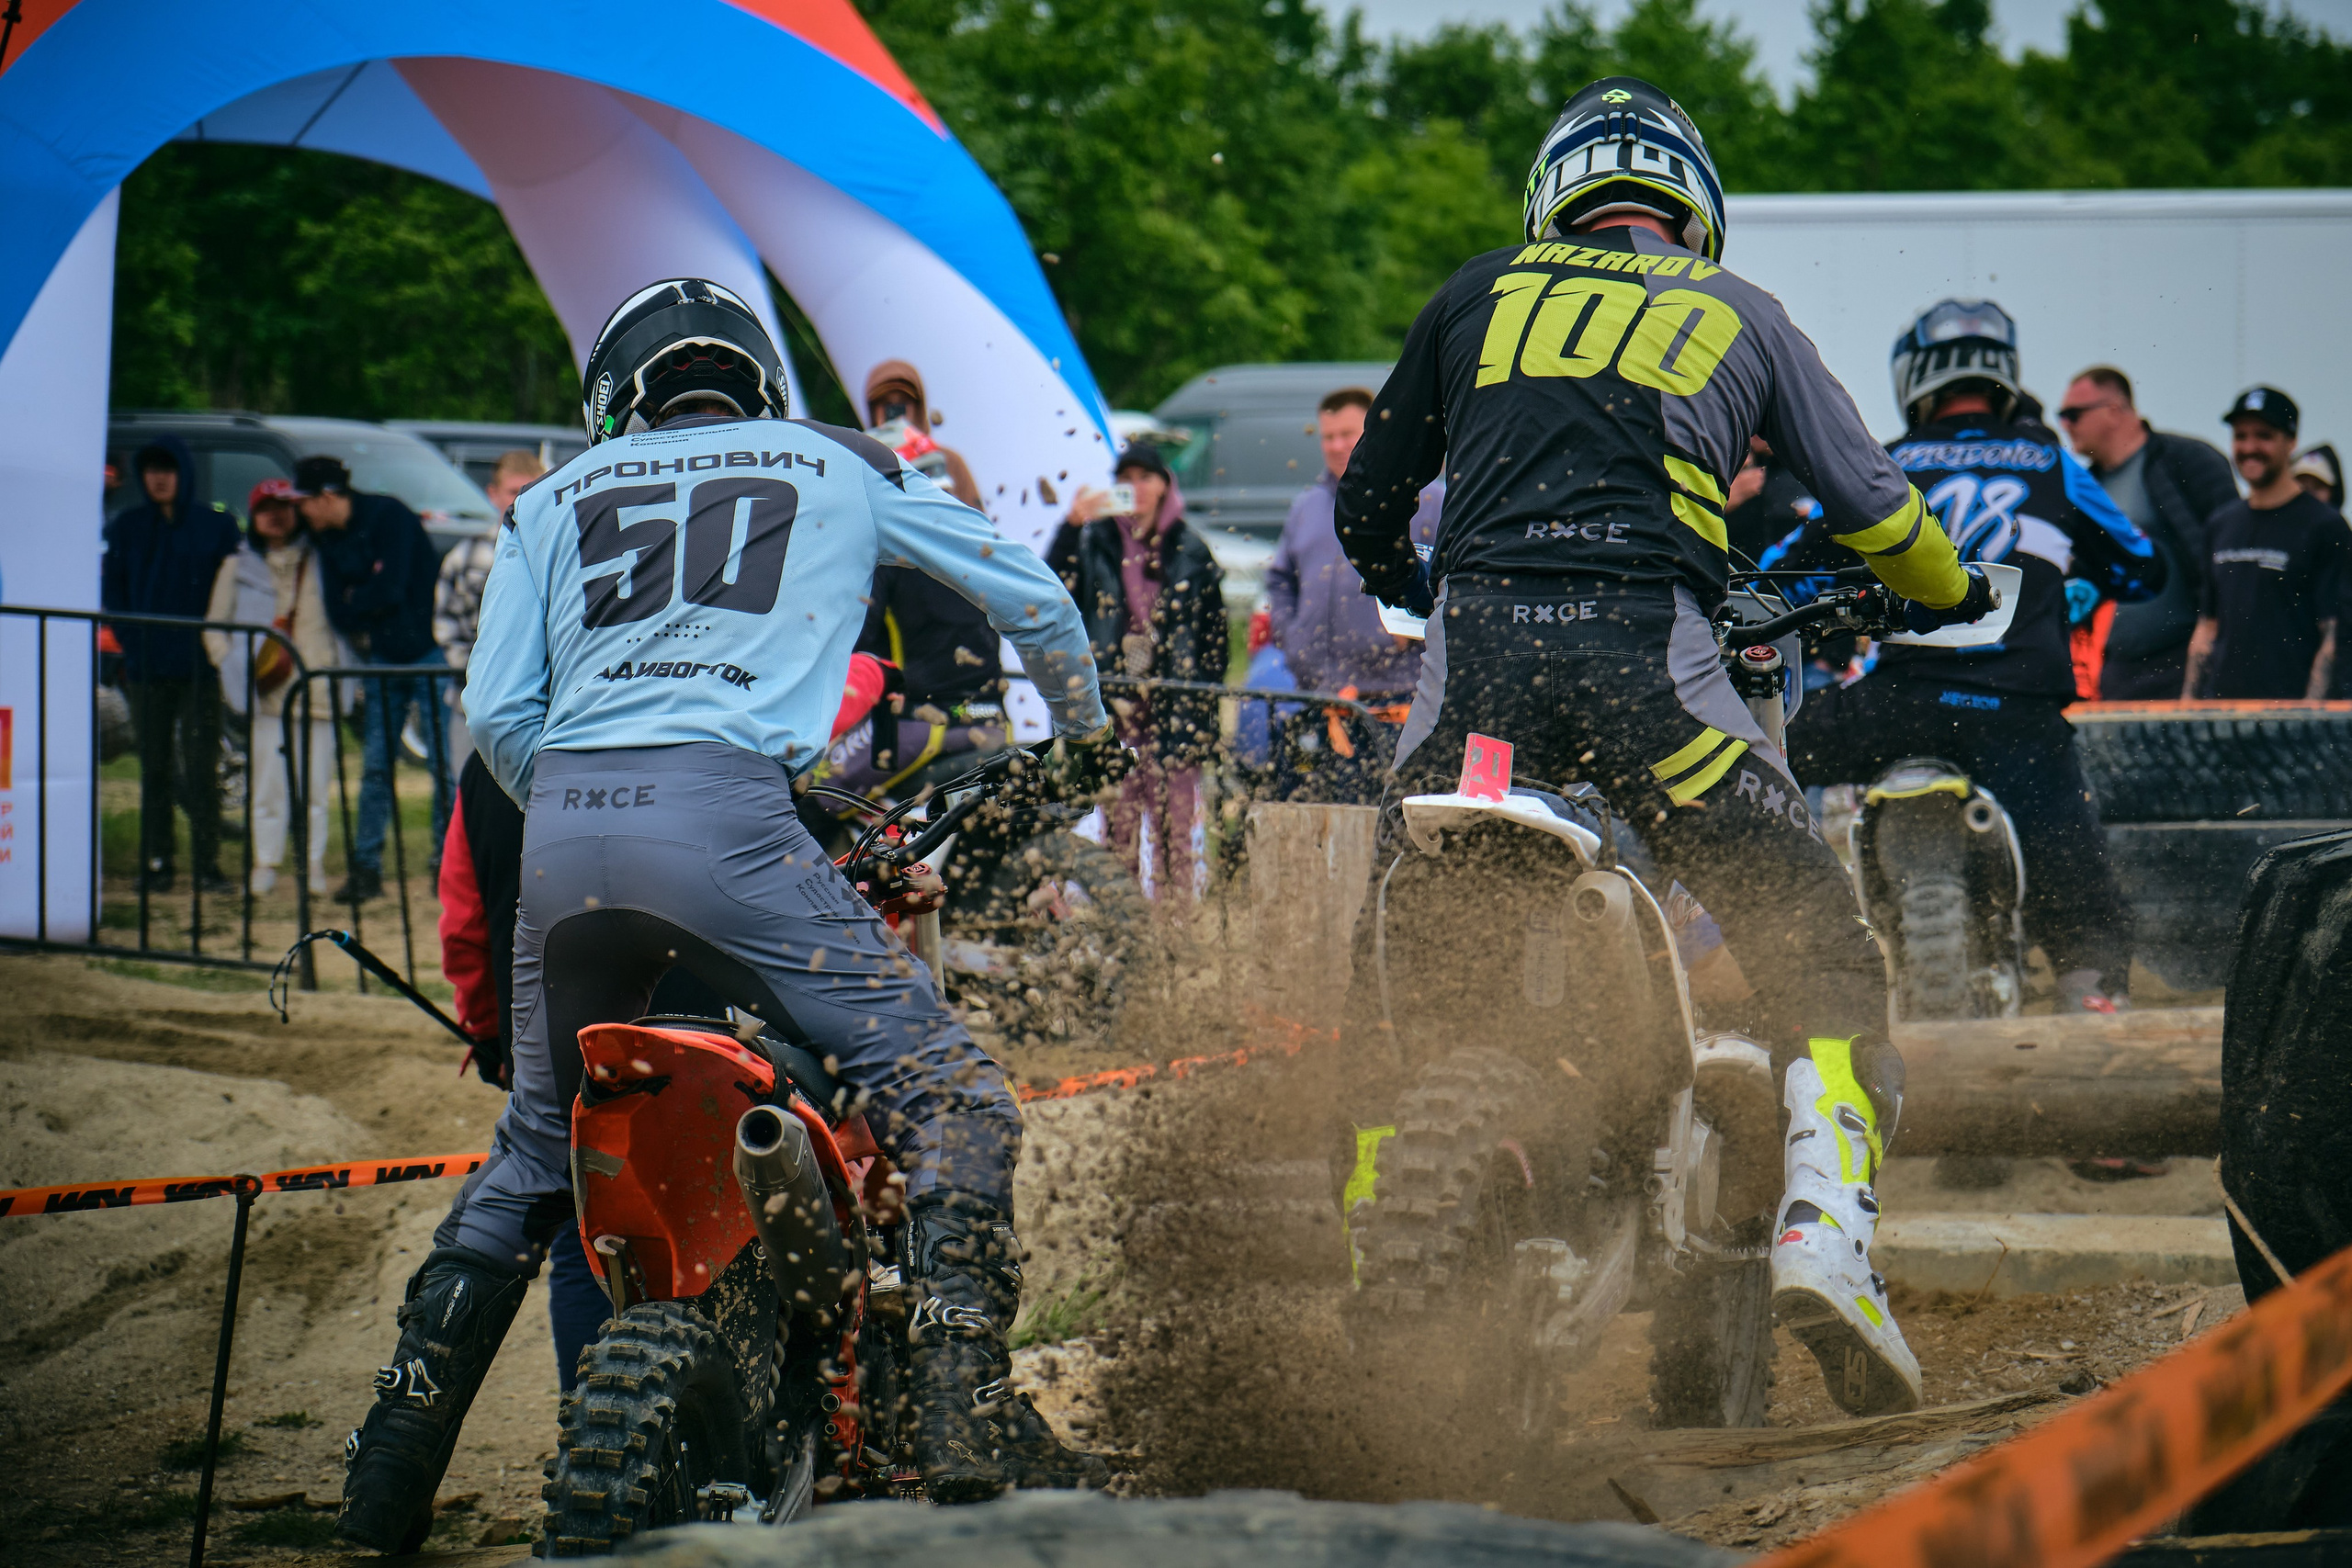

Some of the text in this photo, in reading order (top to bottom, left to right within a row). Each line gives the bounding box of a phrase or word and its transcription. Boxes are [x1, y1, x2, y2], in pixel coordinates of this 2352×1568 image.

[1509, 242, 1723, 282] NAZAROV
[1475, 271, 1744, 397] 100
[595, 378, 611, 427] SHOEI
[553, 450, 825, 507] ПРОНОВИЧ
[572, 476, 799, 632] 50
